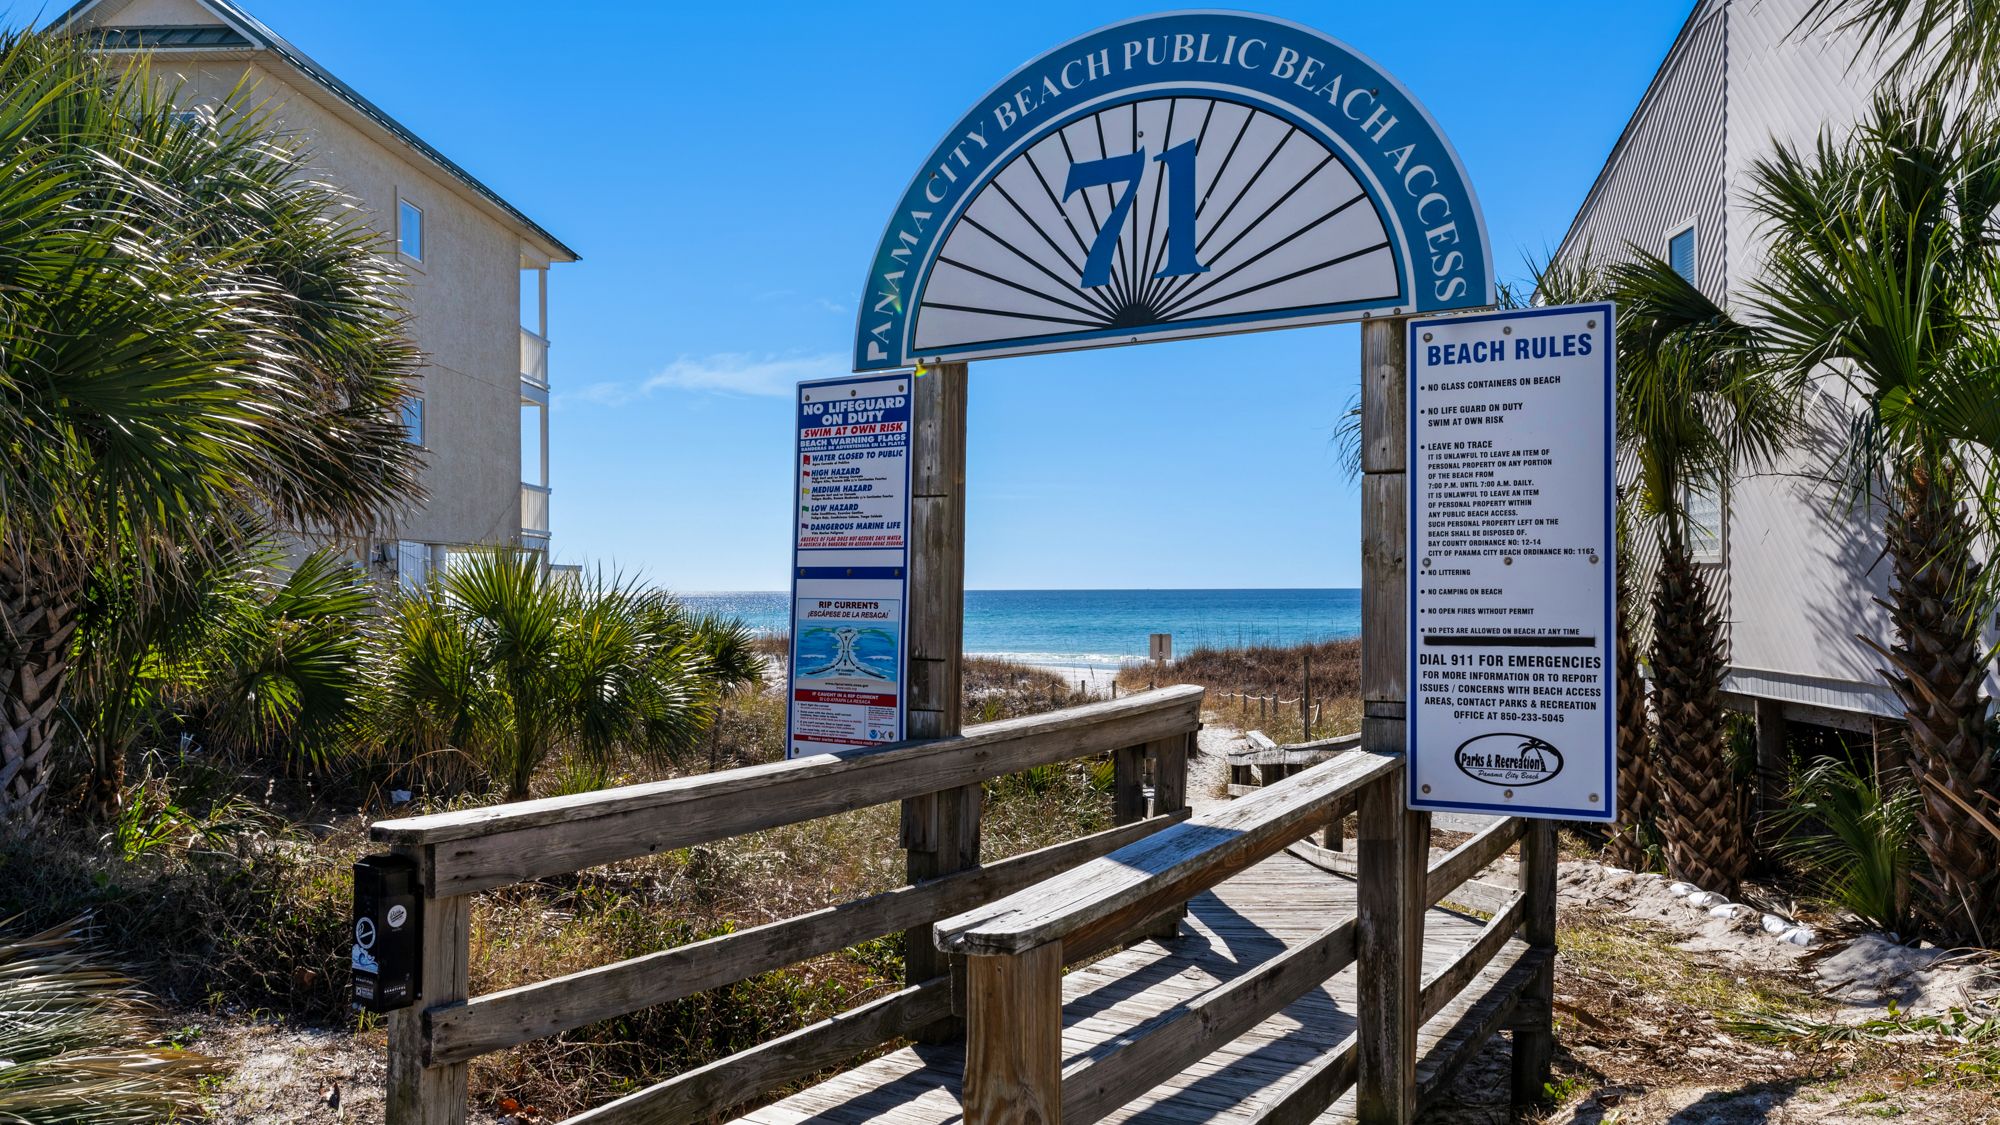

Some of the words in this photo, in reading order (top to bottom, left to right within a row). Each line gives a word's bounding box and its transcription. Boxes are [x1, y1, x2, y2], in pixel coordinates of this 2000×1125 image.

[993, 48, 1111, 132] BEACH
[1123, 33, 1267, 71] PUBLIC
[1270, 46, 1399, 144] BEACH
[1383, 144, 1467, 302] ACCESS
[1062, 138, 1210, 288] 71
[1427, 340, 1504, 366] BEACH
[1515, 332, 1592, 360] RULES
[1427, 383, 1438, 391] NO
[1440, 381, 1465, 390] GLASS
[1467, 378, 1517, 389] CONTAINERS
[1519, 377, 1530, 386] ON
[1533, 375, 1560, 384] BEACH
[804, 404, 823, 415] NO
[828, 397, 905, 413] LIFEGUARD
[1427, 407, 1438, 415] NO
[1440, 406, 1457, 414] LIFE
[1459, 404, 1486, 413] GUARD
[1488, 403, 1499, 412] ON
[1502, 402, 1523, 411] DUTY
[822, 414, 842, 425] ON
[848, 410, 884, 423] DUTY
[1428, 418, 1449, 427] SWIM
[1452, 417, 1462, 426] AT
[1464, 416, 1482, 425] OWN
[1485, 415, 1503, 424] RISK
[804, 428, 831, 438] SWIM
[835, 427, 848, 436] AT
[851, 425, 876, 434] OWN
[880, 422, 903, 432] RISK
[800, 439, 827, 448] BEACH
[830, 436, 874, 445] WARNING
[878, 434, 906, 442] FLAGS
[1427, 442, 1451, 450] LEAVE
[1453, 441, 1464, 449] NO
[1466, 440, 1492, 448] TRACE
[838, 452, 864, 460] CLOSED
[878, 450, 903, 458] PUBLIC
[831, 468, 860, 476] HAZARD
[843, 484, 872, 492] HAZARD
[1577, 547, 1594, 555] 1162
[1470, 627, 1500, 635] ALLOWED
[1502, 627, 1511, 635] ON
[1419, 653, 1447, 665] DIAL
[1451, 654, 1472, 666] 911
[1478, 654, 1503, 666] FOR
[1508, 655, 1601, 668] EMERGENCIES
[1422, 670, 1439, 679] FOR
[1442, 671, 1466, 679] MORE
[1469, 671, 1529, 681] INFORMATION
[1532, 672, 1544, 682] OR
[1547, 673, 1558, 682] TO
[1561, 673, 1597, 683] REPORT
[1419, 683, 1449, 692] ISSUES
[1451, 684, 1455, 693] /
[1458, 684, 1504, 694] CONCERNS
[1507, 685, 1529, 694] WITH
[1532, 686, 1562, 695] BEACH
[1565, 687, 1601, 696] ACCESS
[1424, 696, 1454, 706] AREAS,
[1456, 697, 1496, 706] CONTACT
[1499, 698, 1527, 708] PARKS
[1530, 699, 1536, 708] &
[1540, 700, 1596, 710] RECREATION
[1454, 710, 1484, 719] OFFICE
[1486, 711, 1498, 720] AT
[1500, 712, 1564, 722] 850-233-5045
[1461, 753, 1484, 767] Parks
[1495, 754, 1540, 770] Recreation
[1504, 771, 1518, 780] City
